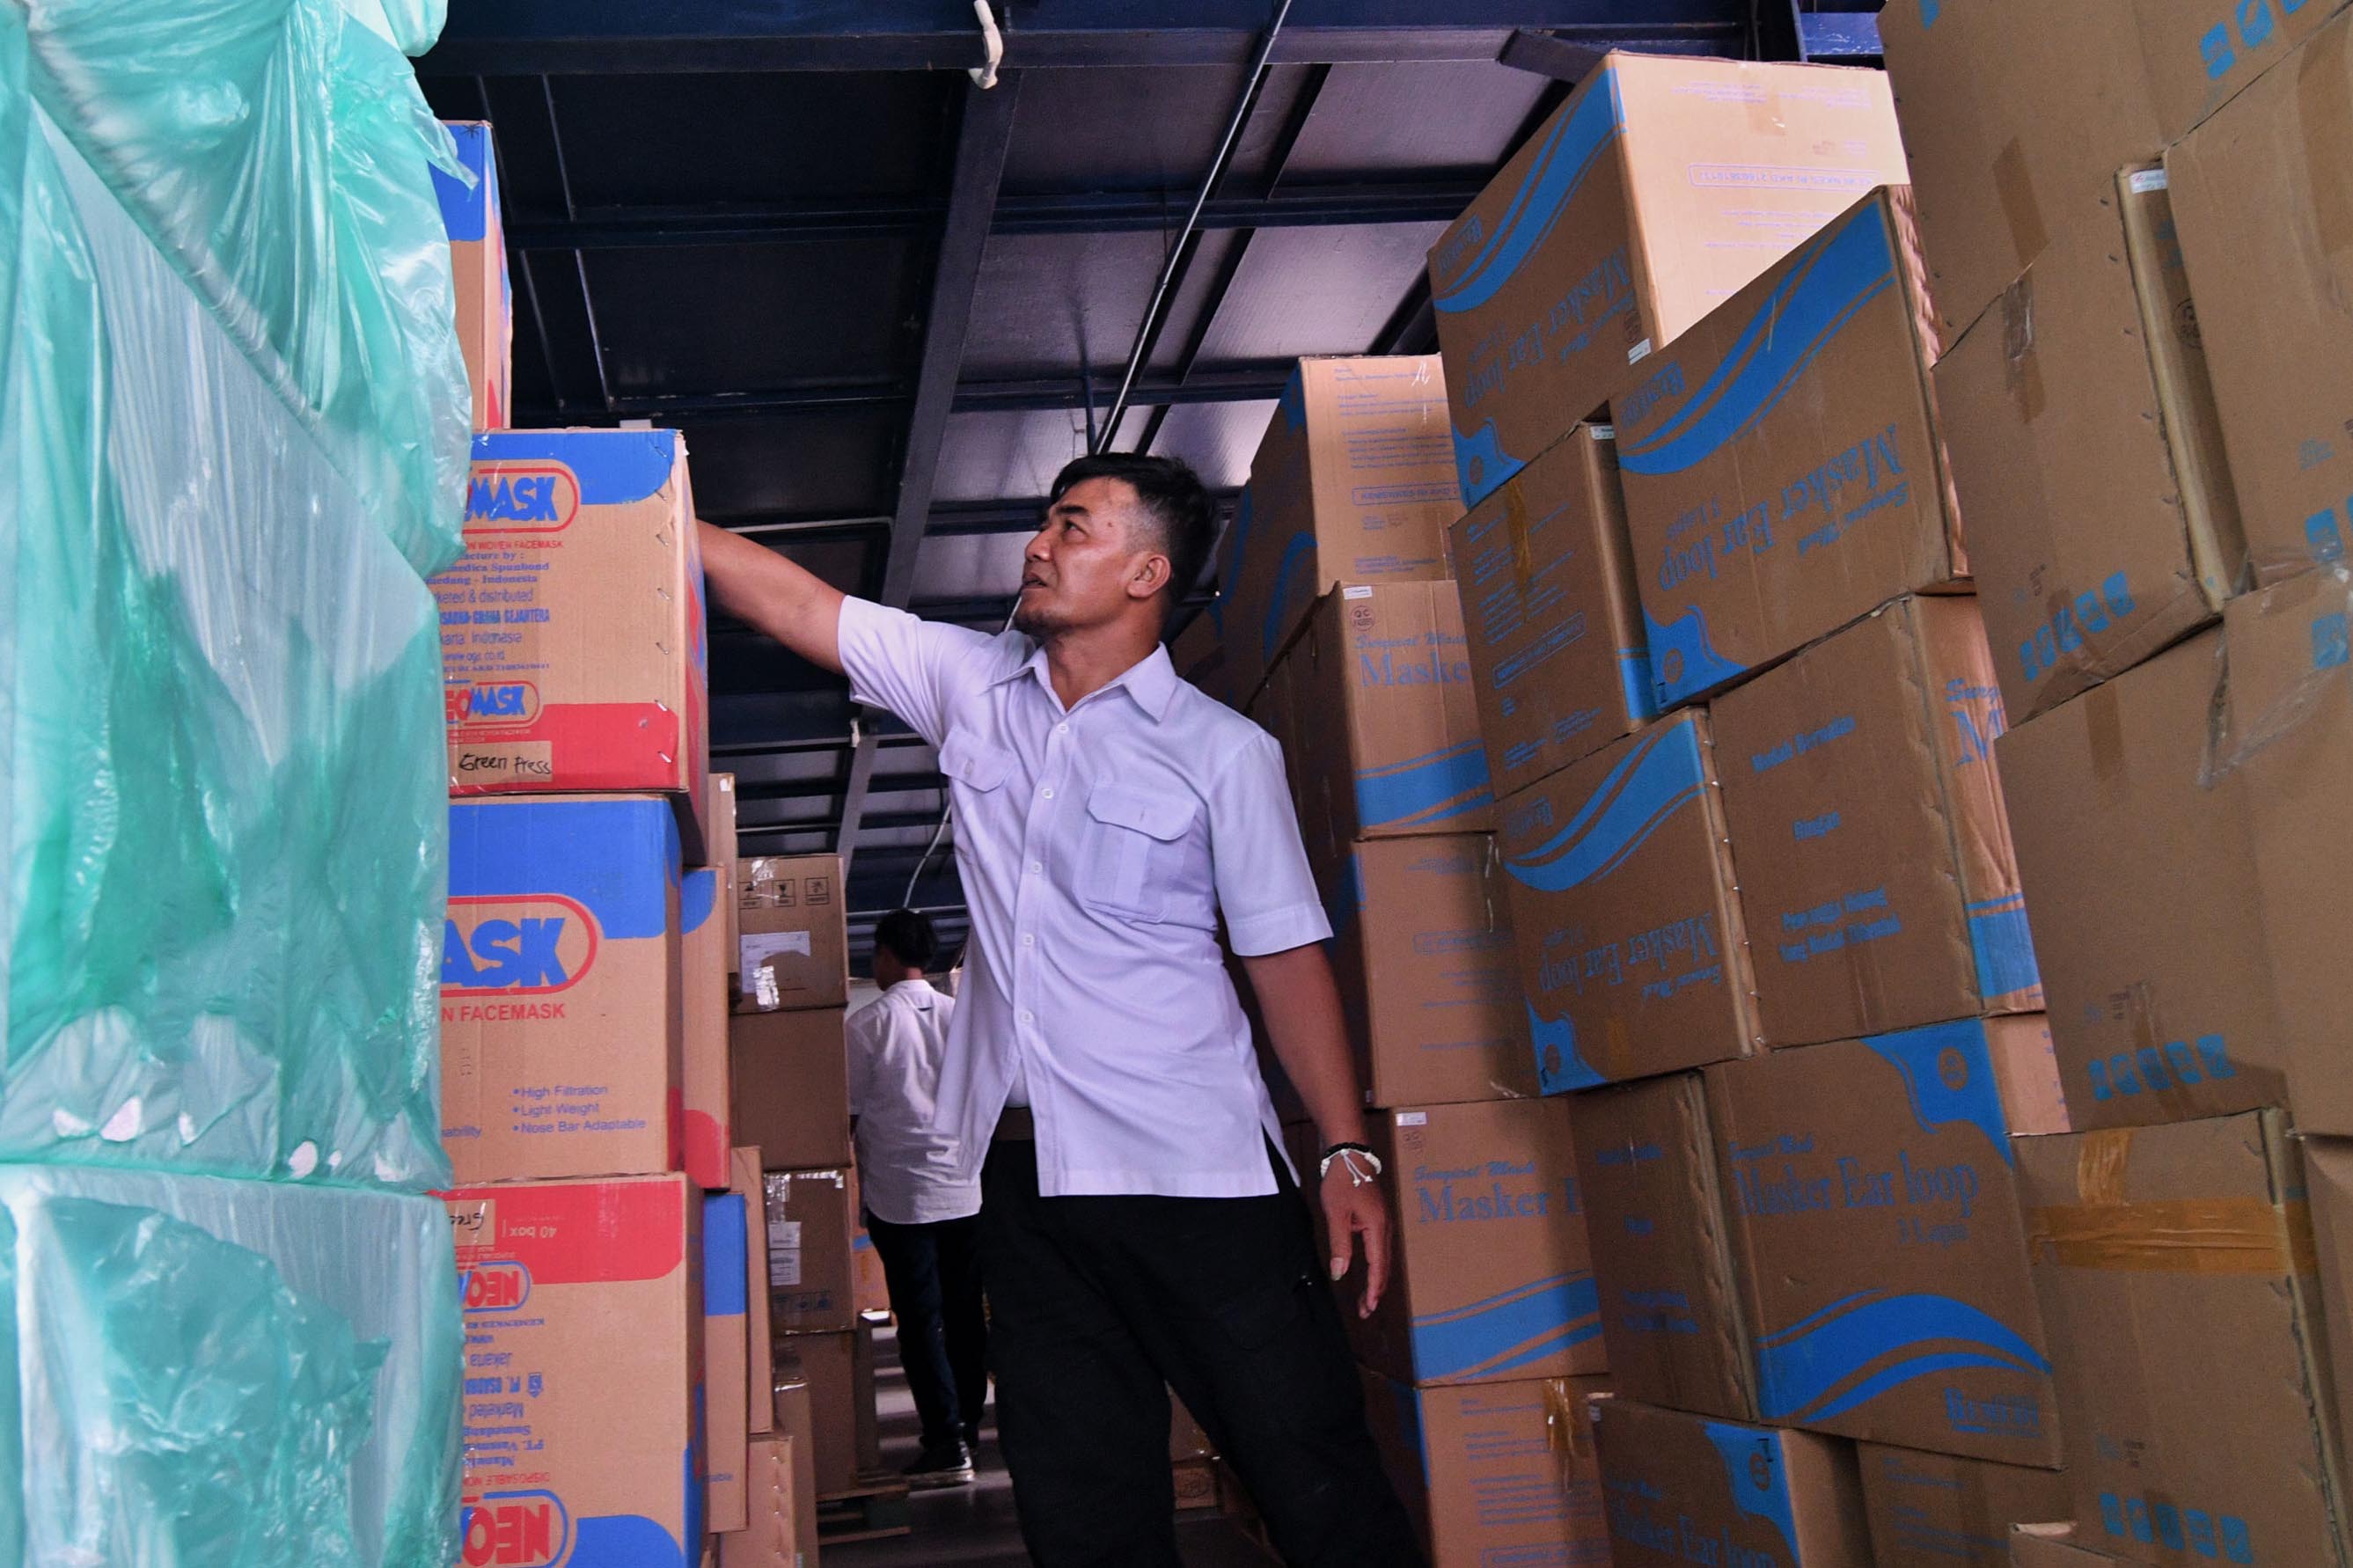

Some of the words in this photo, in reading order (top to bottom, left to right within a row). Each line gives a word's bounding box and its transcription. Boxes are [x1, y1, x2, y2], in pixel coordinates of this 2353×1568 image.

[1780, 423, 1905, 521] Masker
[465, 476, 558, 521] MASK
[1722, 500, 1775, 555] Ear
[1658, 535, 1718, 591] loop
[1360, 649, 1470, 688] Maske
[445, 685, 525, 721] EOMASK
[1945, 678, 2002, 704] Surg
[441, 917, 569, 988] ASK
[1628, 910, 1719, 971] Masker
[460, 1003, 565, 1021] FACEMASK
[521, 1086, 550, 1100] High
[554, 1085, 608, 1096] Filtration
[521, 1105, 553, 1117] Light
[556, 1103, 599, 1116] Weight
[521, 1122, 554, 1133] Nose
[558, 1120, 579, 1132] Bar
[583, 1117, 647, 1131] Adaptable
[1415, 1182, 1555, 1224] Masker
[1733, 1163, 1832, 1217] Masker
[1836, 1156, 1895, 1209] Ear
[1899, 1148, 1979, 1219] loop
[509, 1225, 536, 1238] box
[539, 1225, 558, 1239] 40
